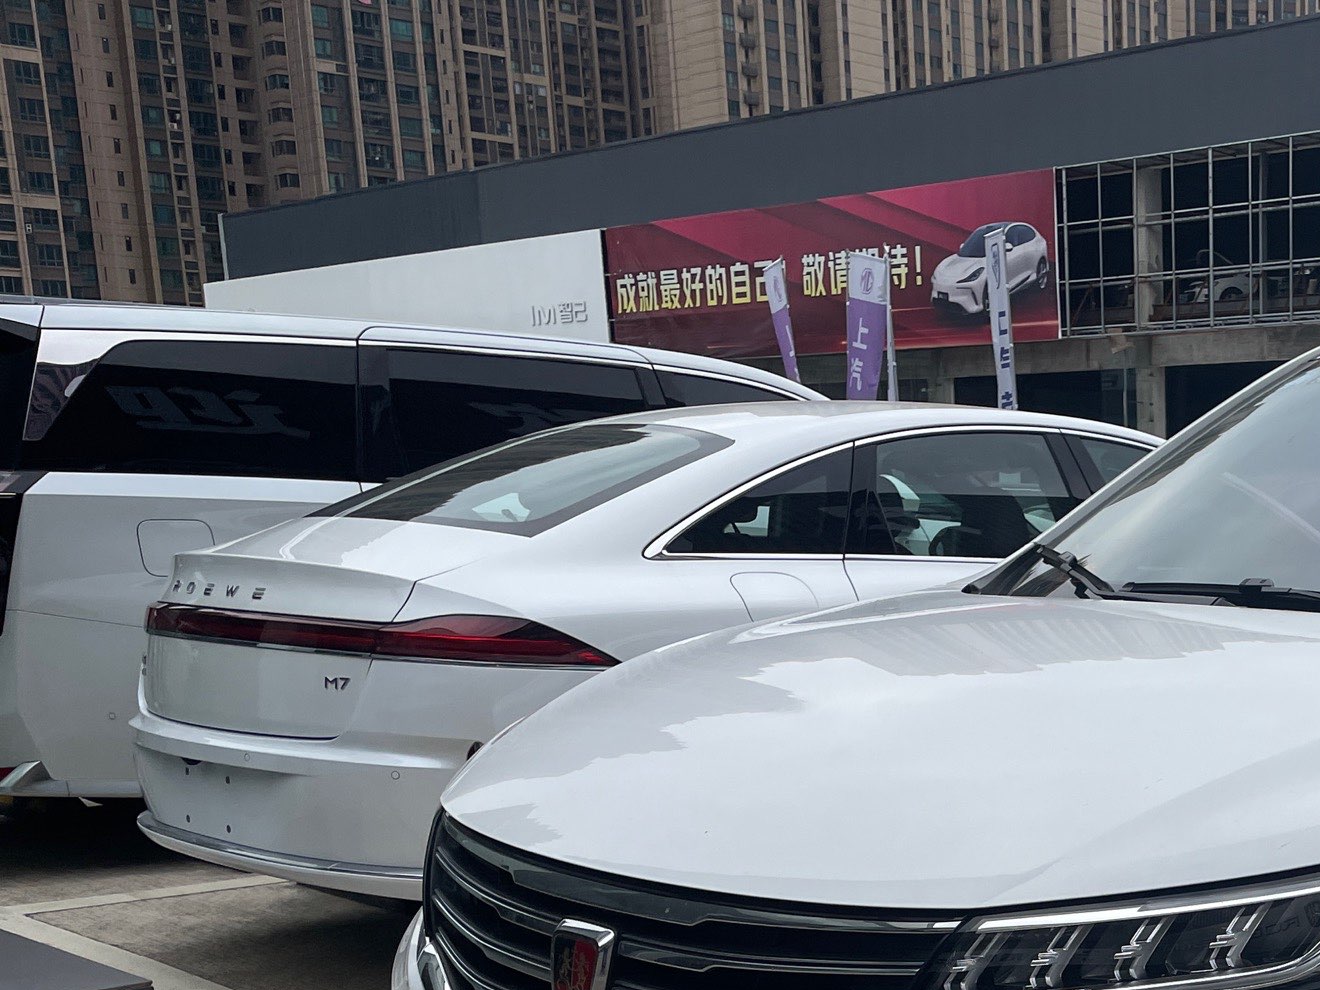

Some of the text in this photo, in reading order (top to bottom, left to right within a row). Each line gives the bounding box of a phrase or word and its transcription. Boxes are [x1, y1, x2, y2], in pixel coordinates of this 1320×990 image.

[801, 244, 922, 297] 敬请待!
[172, 579, 267, 600] ROEWE
[324, 675, 351, 691] M7
